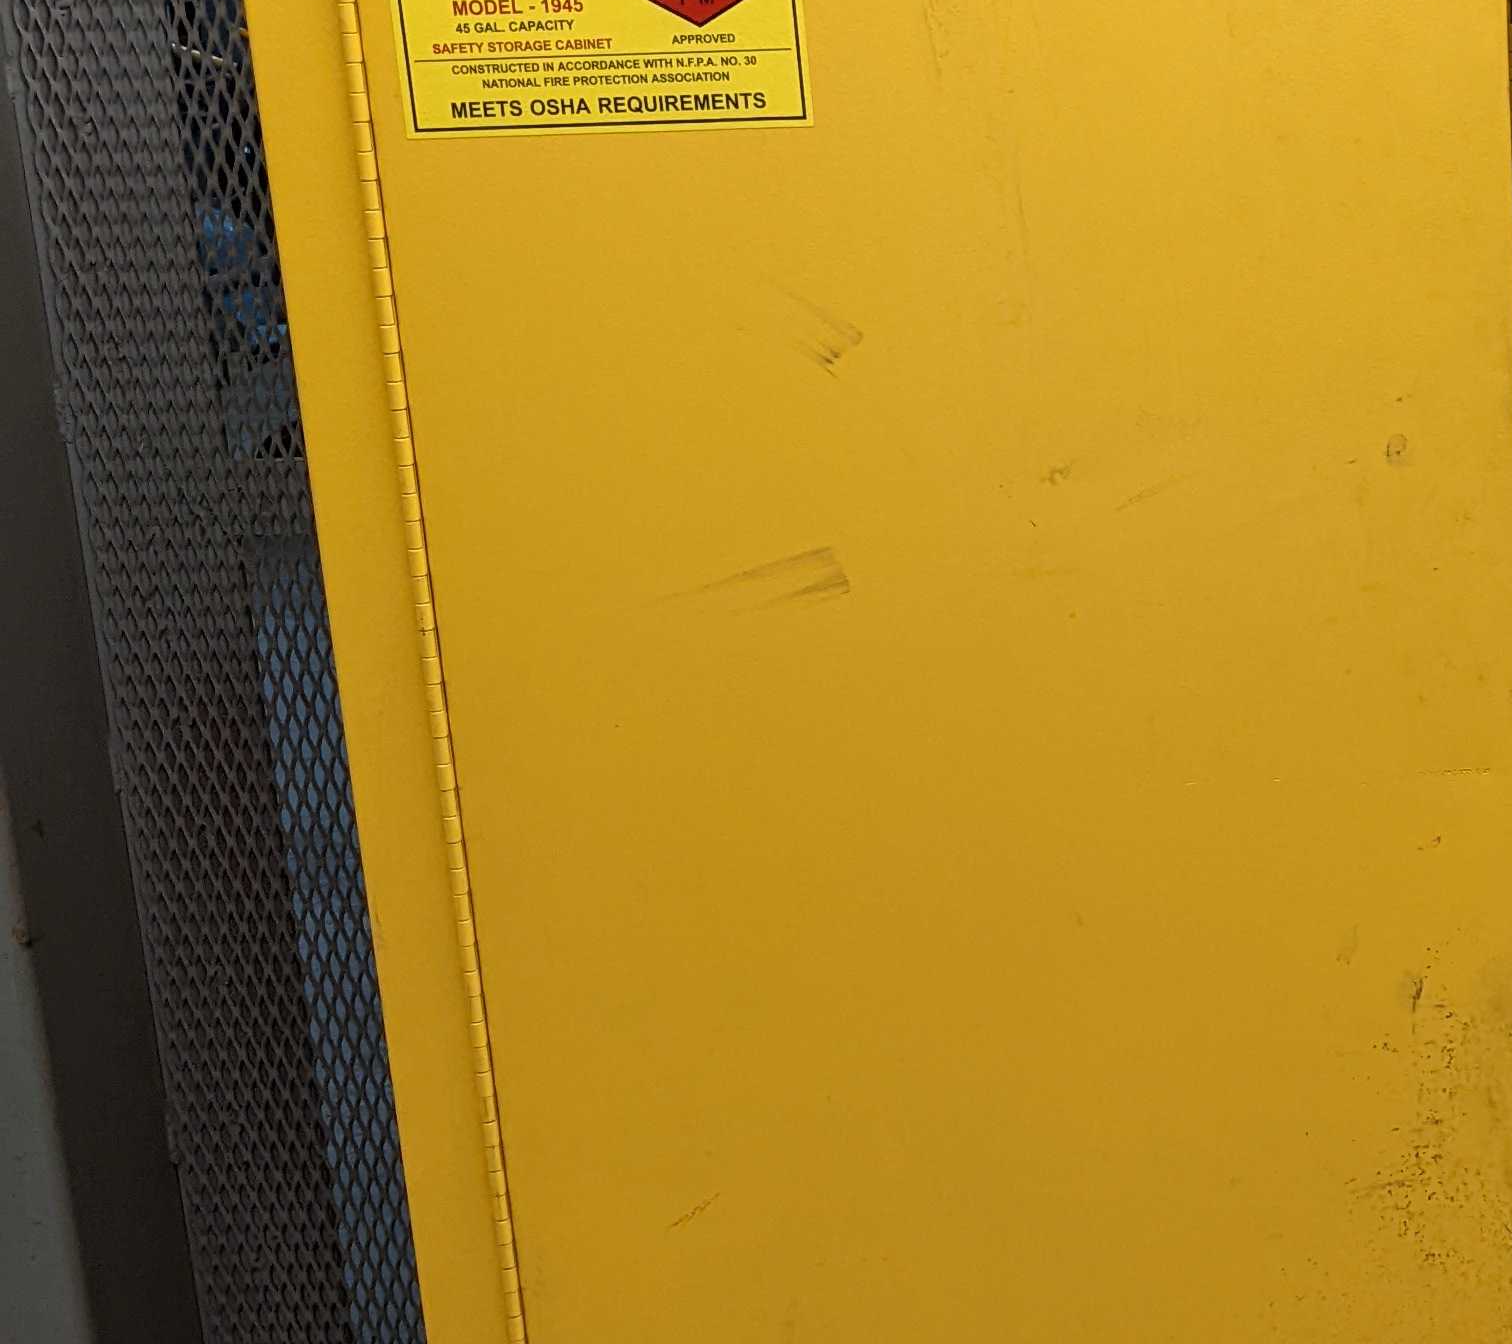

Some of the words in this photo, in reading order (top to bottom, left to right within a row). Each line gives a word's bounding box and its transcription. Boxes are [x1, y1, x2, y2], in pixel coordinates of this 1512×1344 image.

[452, 0, 523, 16] MODEL
[456, 23, 470, 34] 45
[474, 22, 505, 34] GAL.
[509, 19, 574, 32] CAPACITY
[432, 42, 484, 54] SAFETY
[488, 40, 552, 53] STORAGE
[555, 38, 612, 51] CABINET
[672, 33, 735, 44] APPROVED
[451, 62, 540, 75] CONSTRUCTED
[542, 62, 554, 72] IN
[558, 59, 640, 72] ACCORDANCE
[643, 58, 673, 69] WITH
[720, 56, 741, 66] NO.
[744, 55, 757, 66] 30
[482, 77, 541, 89] NATIONAL
[543, 76, 570, 87] FIRE
[573, 74, 648, 86] PROTECTION
[651, 71, 730, 83] ASSOCIATION
[451, 100, 523, 119] MEETS
[530, 98, 591, 116] OSHA
[598, 92, 766, 114] REQUIREMENTS
